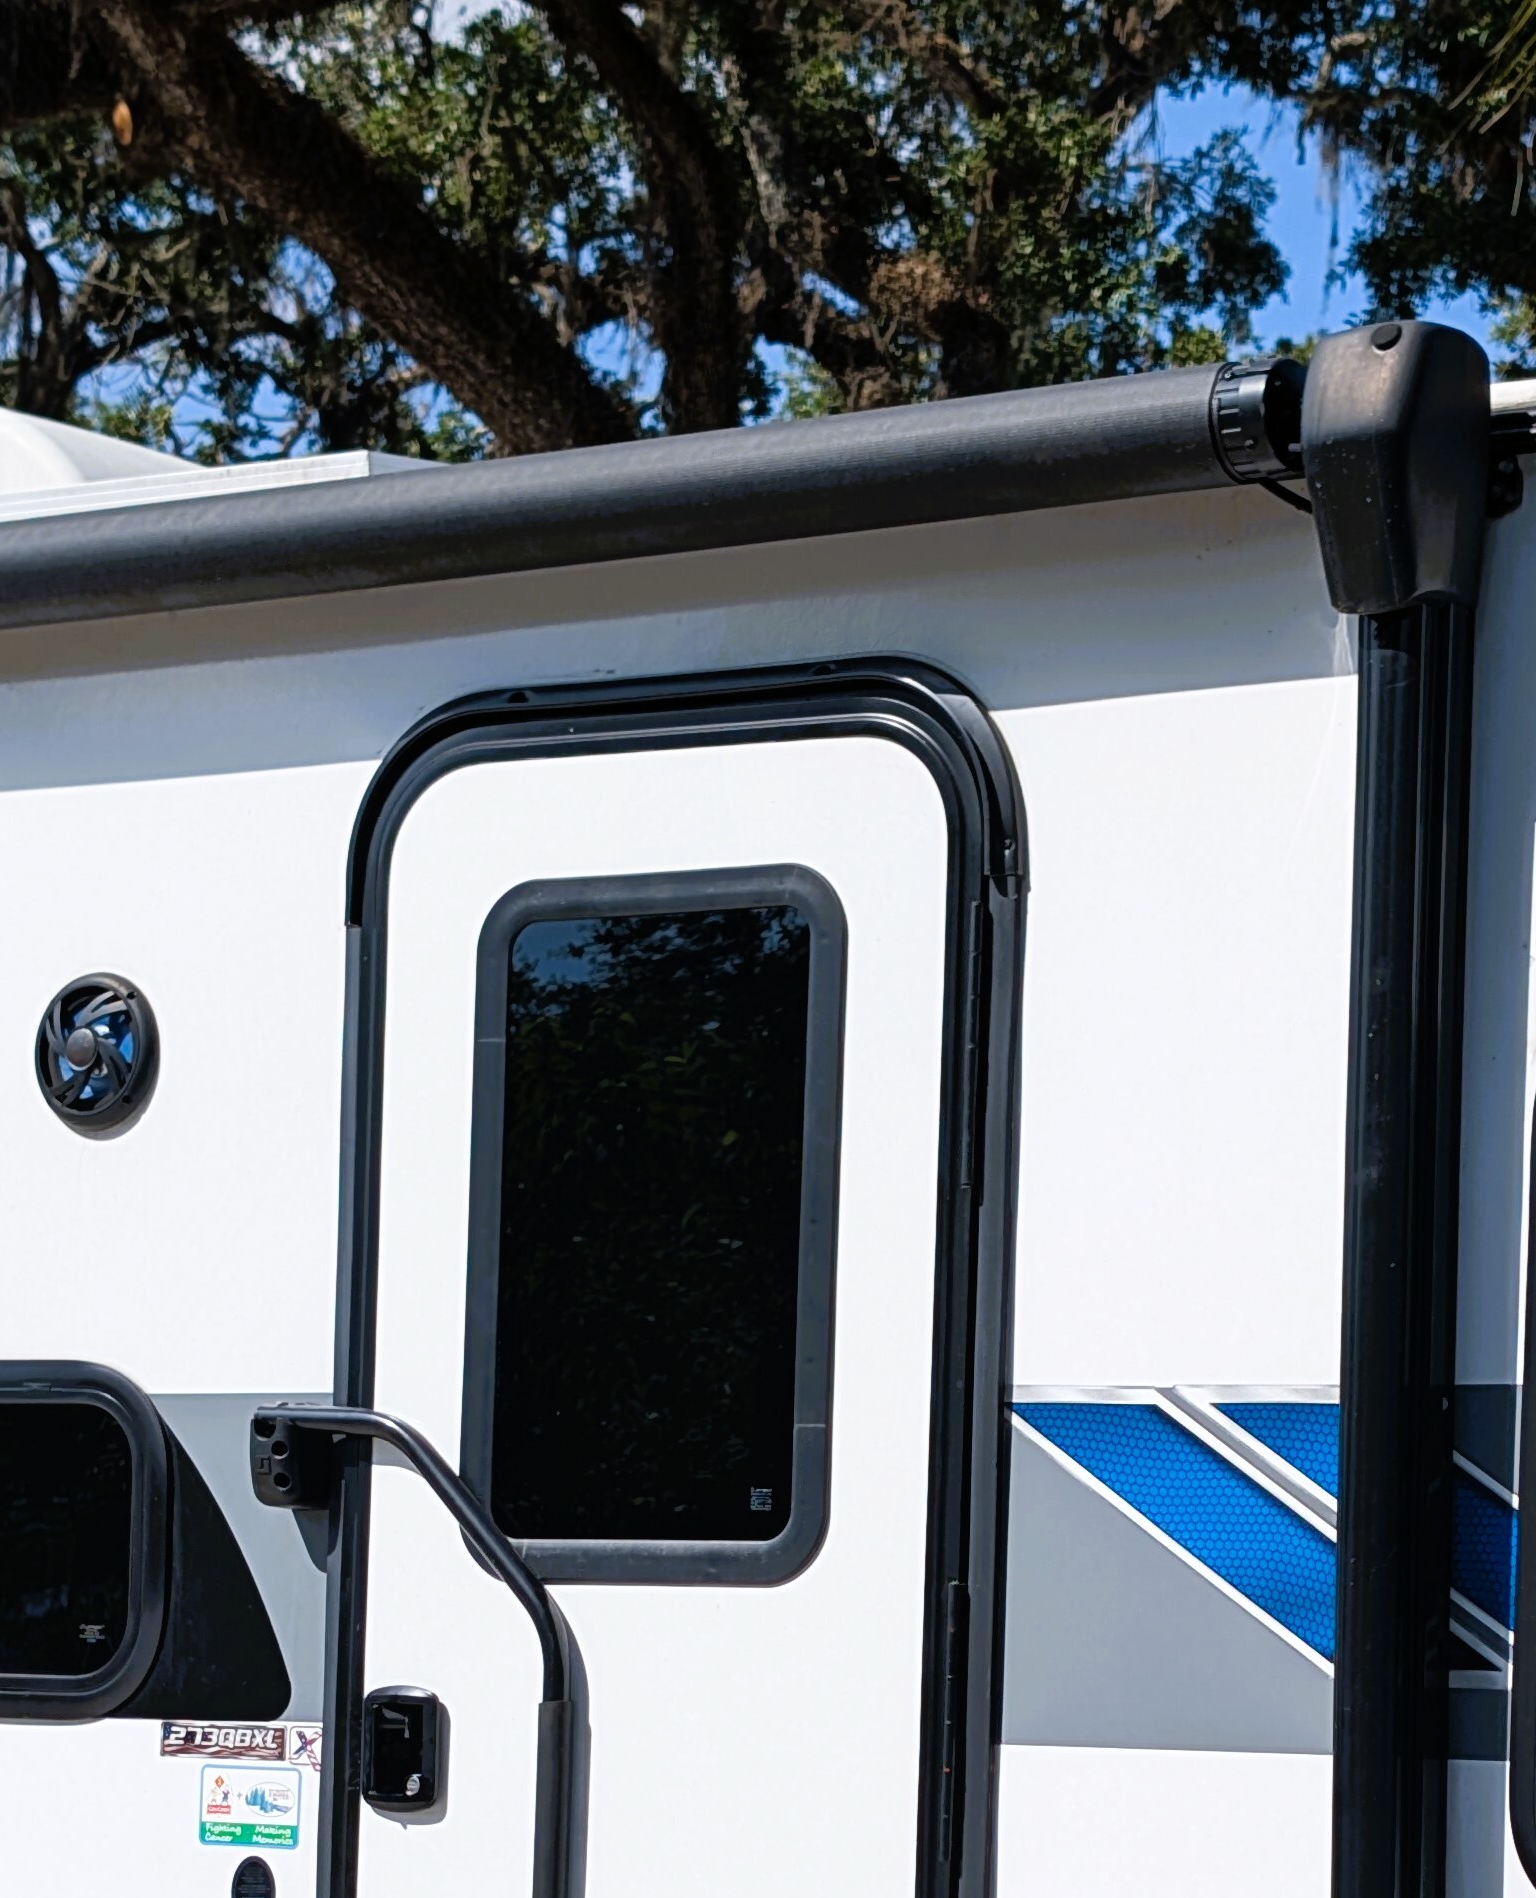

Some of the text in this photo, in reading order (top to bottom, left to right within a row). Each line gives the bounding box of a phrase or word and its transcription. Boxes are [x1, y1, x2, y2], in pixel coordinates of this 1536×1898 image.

[166, 1725, 278, 1750] 273QBXL
[205, 1822, 292, 1838] Fighting Making
